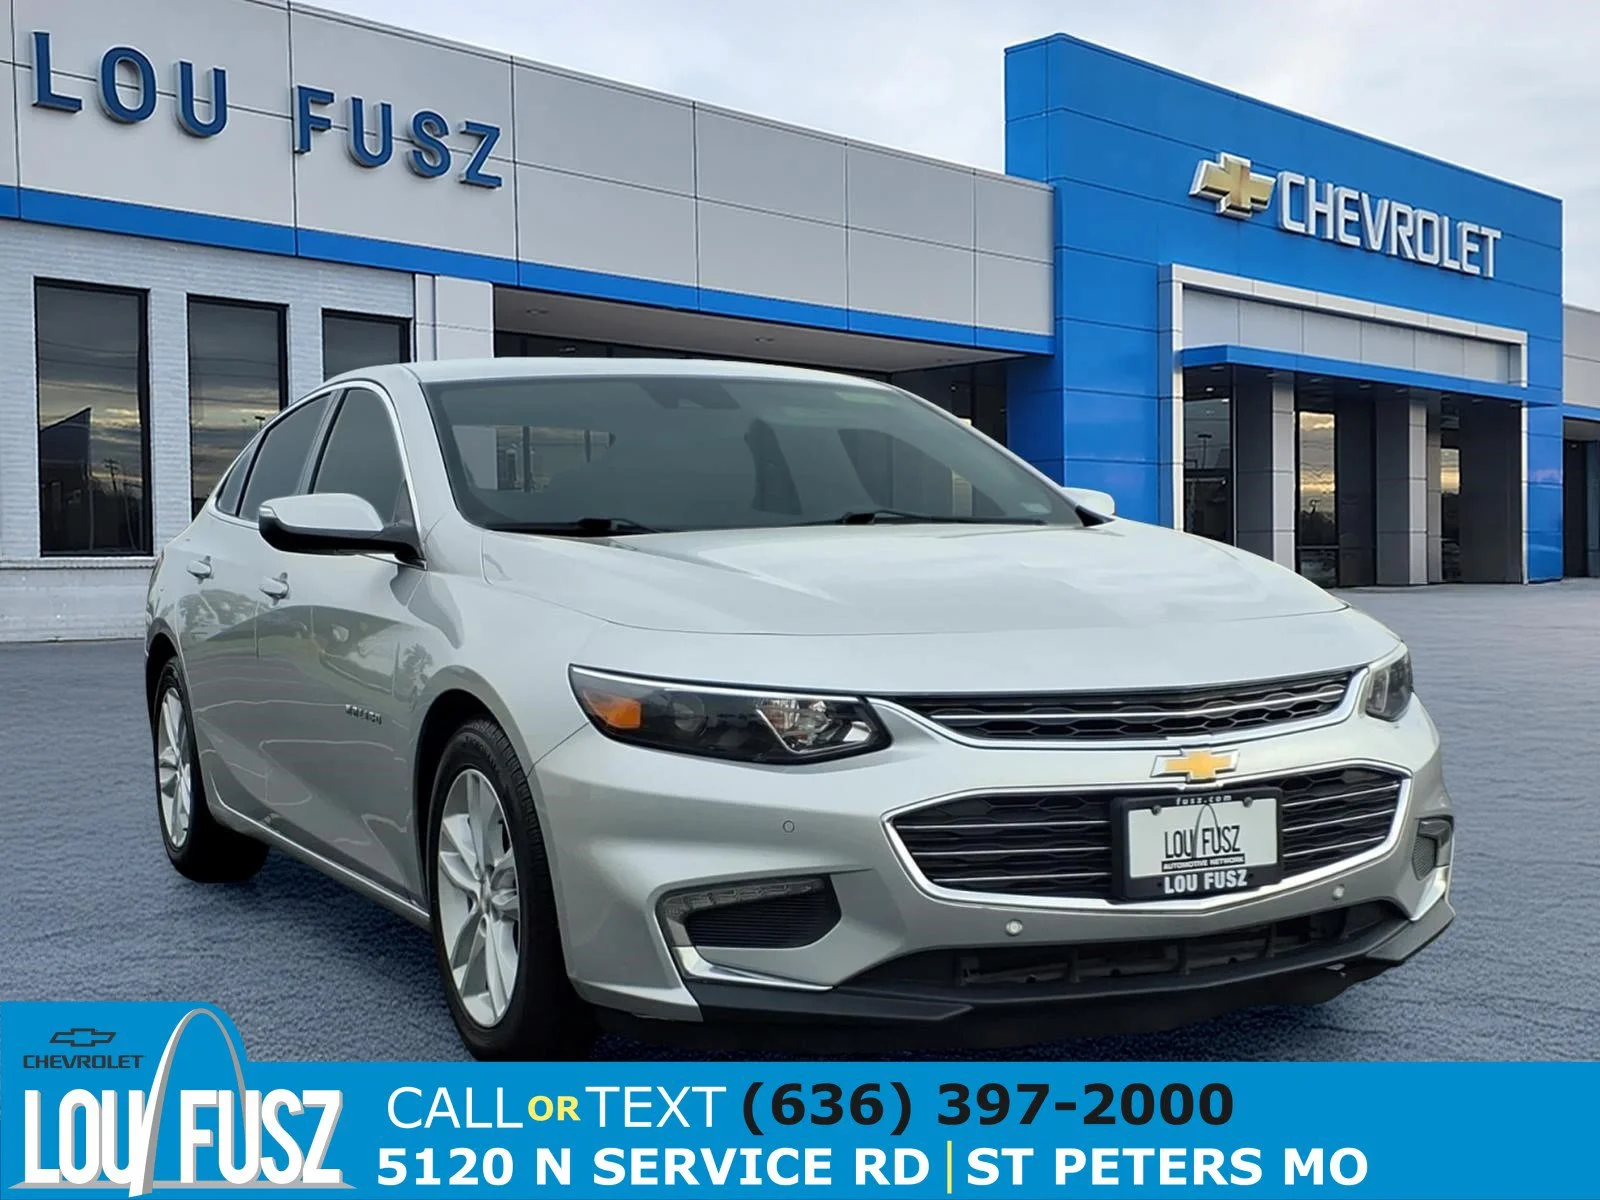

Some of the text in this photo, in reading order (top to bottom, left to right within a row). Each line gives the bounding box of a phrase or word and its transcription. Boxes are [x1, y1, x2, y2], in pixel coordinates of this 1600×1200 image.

[31, 31, 503, 189] LOU FUSZ
[1277, 171, 1501, 278] CHEVROLET
[1176, 795, 1232, 805] fusz.com
[1164, 825, 1241, 859] LOU FUSZ
[1163, 856, 1244, 870] AUTOMOTIVE NETWORK
[1164, 869, 1248, 894] LOU FUSZ
